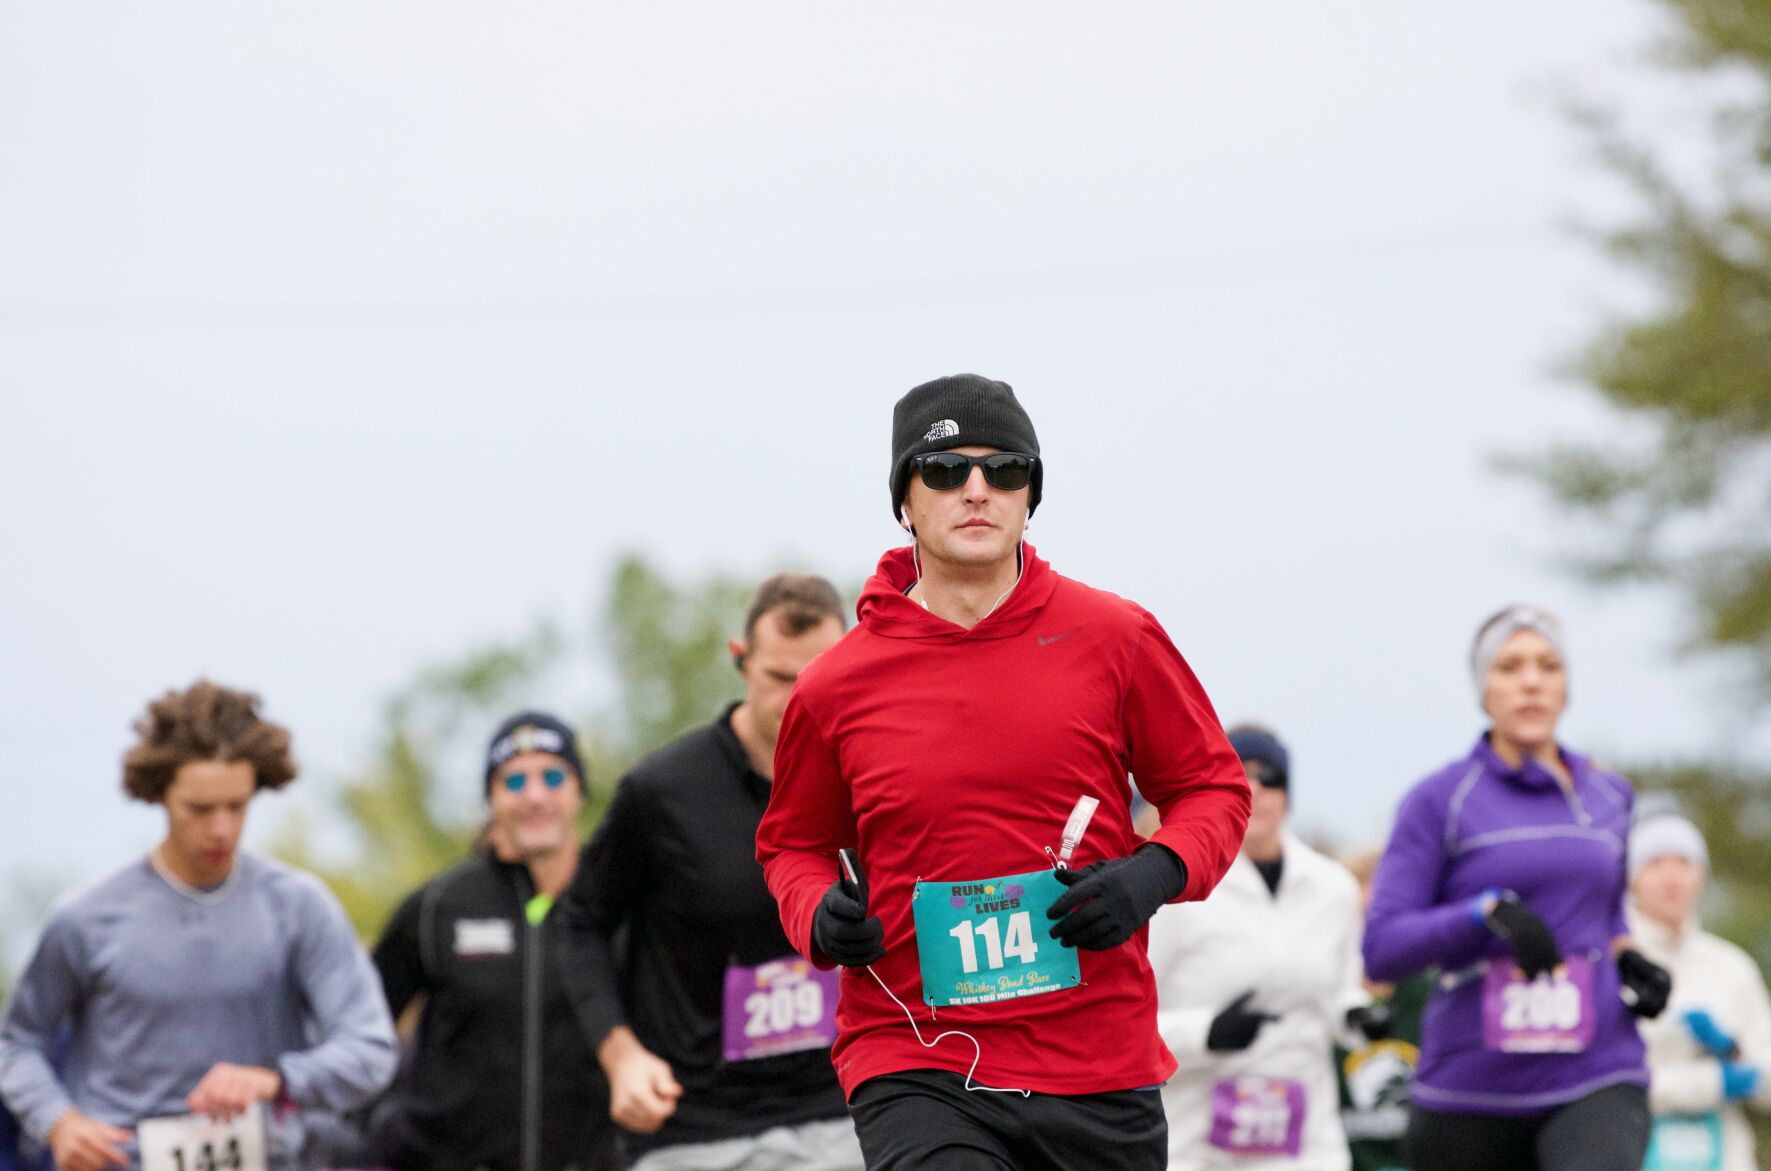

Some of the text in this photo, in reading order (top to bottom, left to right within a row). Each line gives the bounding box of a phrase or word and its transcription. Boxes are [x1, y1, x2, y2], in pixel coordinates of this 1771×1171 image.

[931, 420, 945, 429] THE
[952, 884, 984, 896] RUN
[976, 898, 1020, 914] LIVES
[950, 911, 1038, 973] 114
[955, 980, 996, 996] Whiskey
[998, 975, 1023, 991] Road
[1017, 984, 1060, 996] Challenge
[744, 980, 823, 1037] 209
